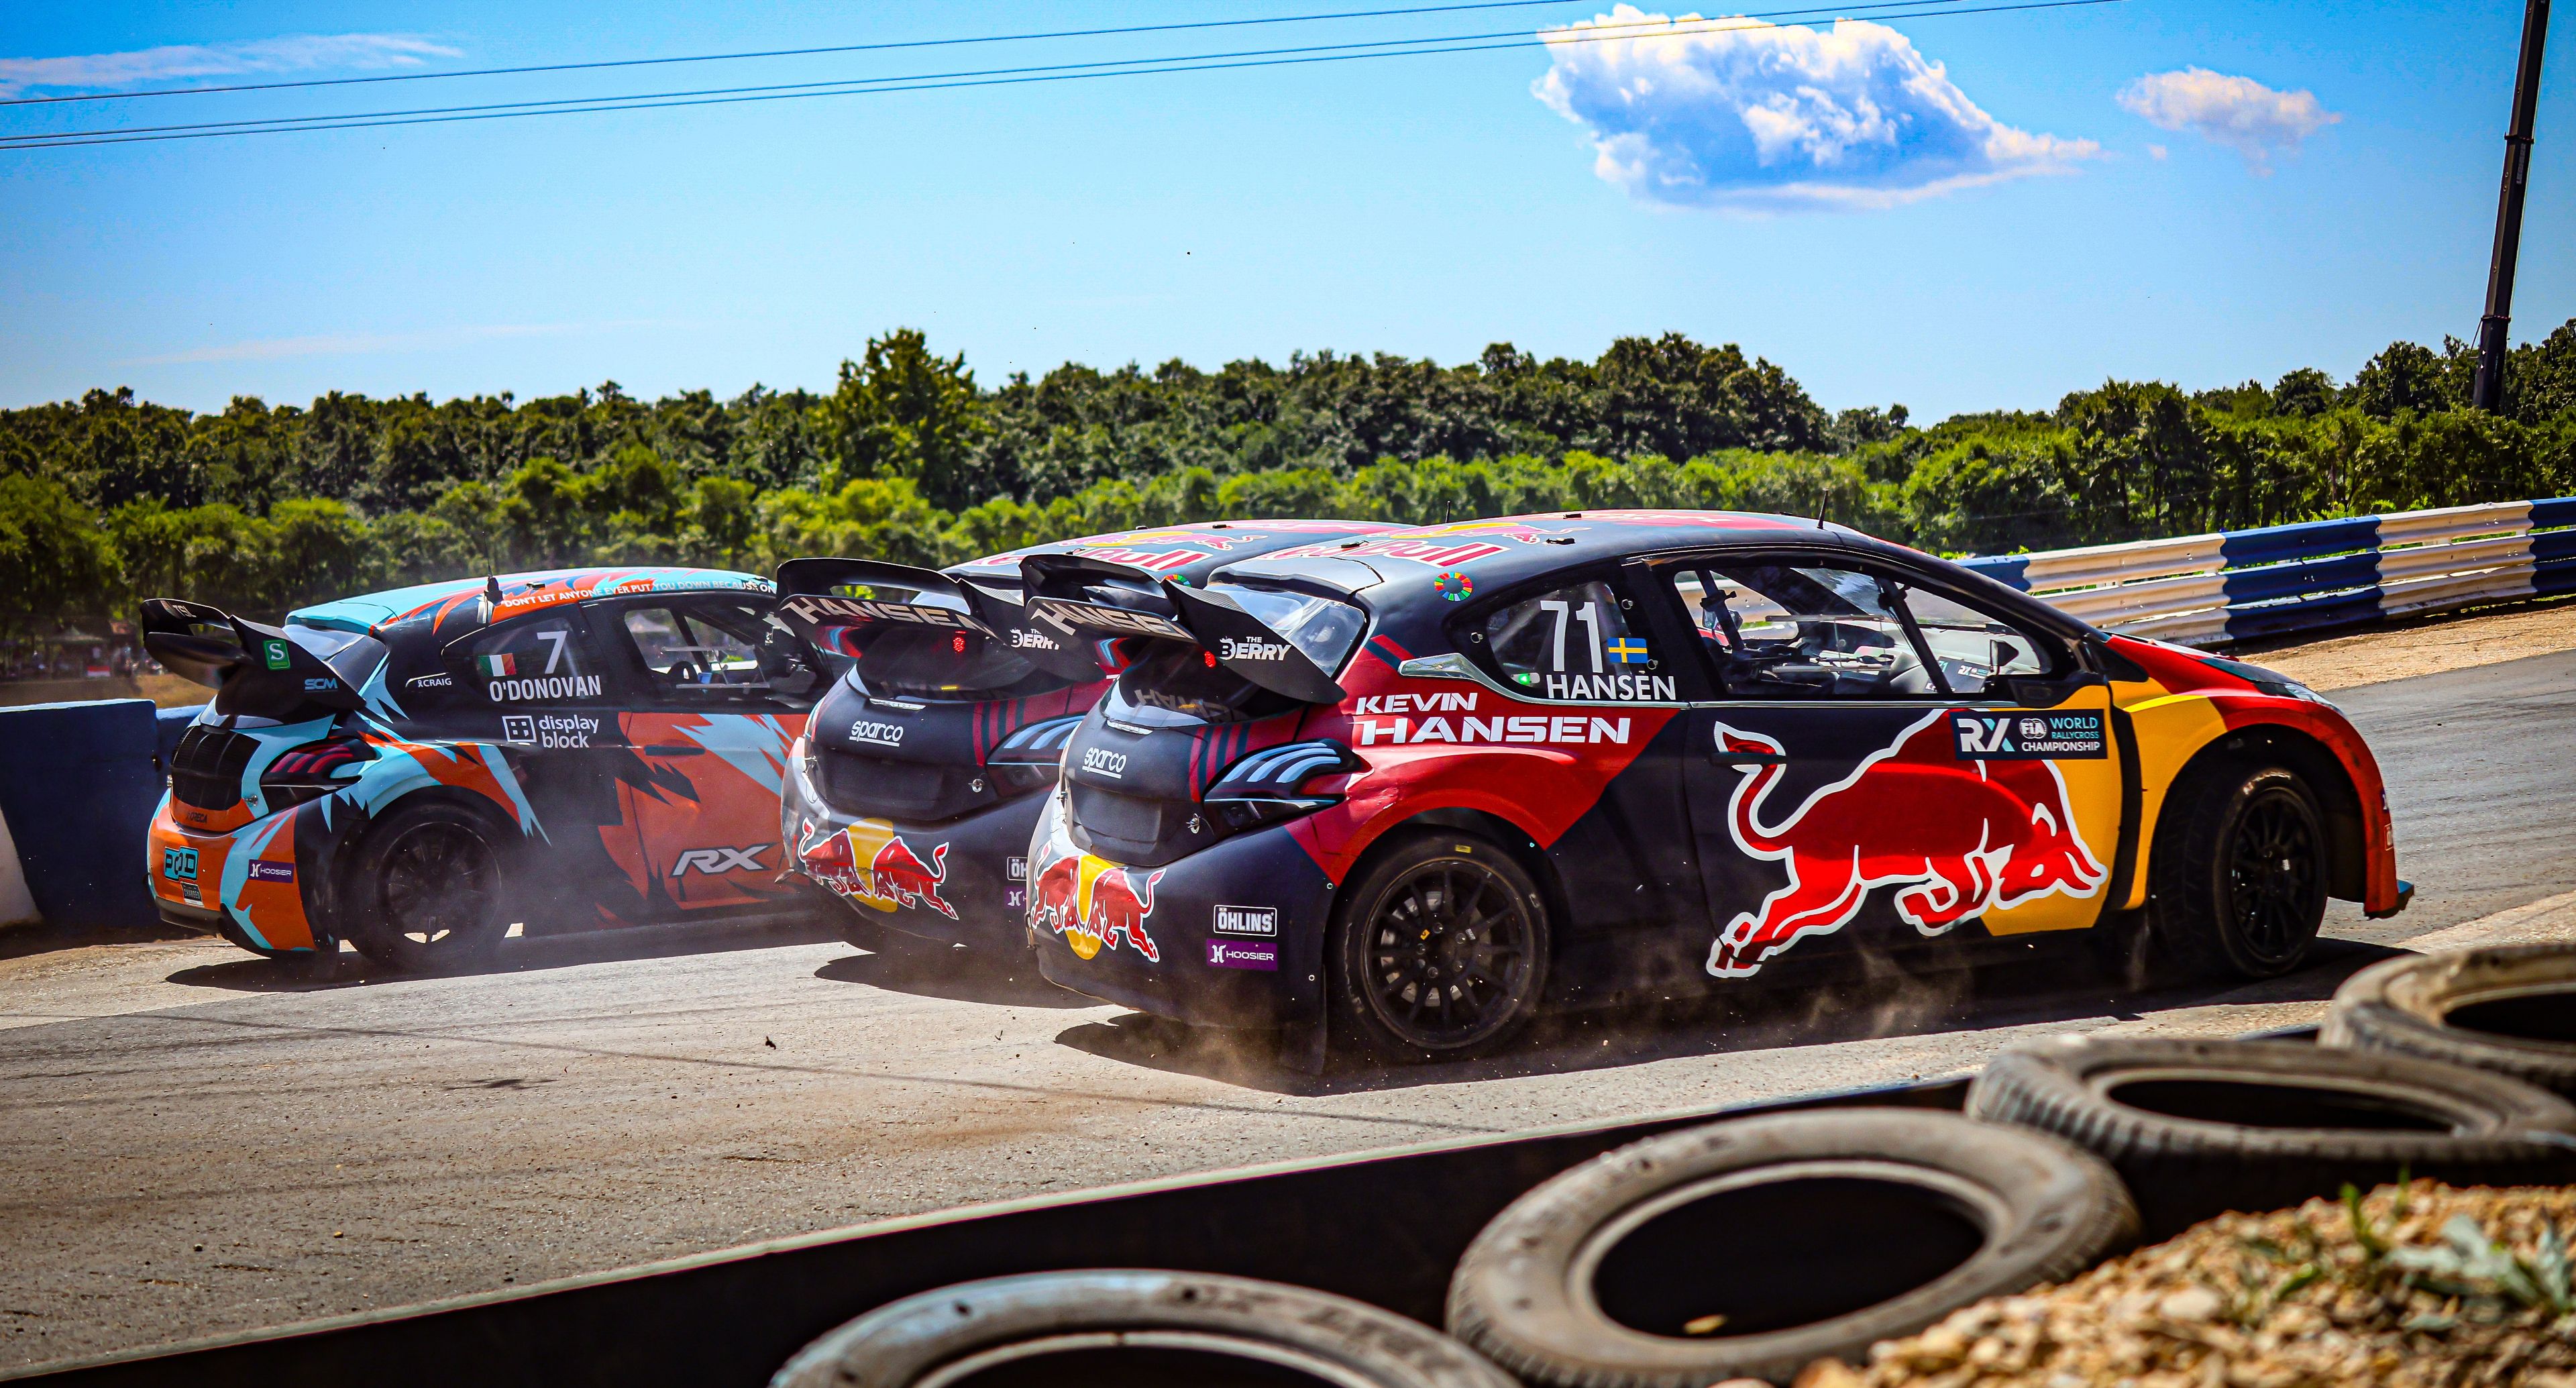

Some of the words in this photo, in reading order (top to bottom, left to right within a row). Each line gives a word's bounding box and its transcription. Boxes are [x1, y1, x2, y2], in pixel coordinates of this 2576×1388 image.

[540, 594, 556, 602] LET
[559, 588, 602, 599] ANYONE
[605, 586, 627, 596] EVER
[632, 584, 651, 592] PUT
[653, 582, 676, 590] YOU
[678, 581, 710, 590] DOWN
[714, 580, 759, 592] BECAUSE
[1541, 600, 1603, 673] 71
[269, 643, 285, 661] S
[537, 631, 568, 674] 7
[1220, 636, 1291, 661] BERRY
[305, 678, 338, 690] SCM
[425, 678, 452, 688] CRAIG
[489, 675, 602, 702] O'DONOVAN
[1546, 674, 1676, 700] HANSEN
[1355, 692, 1477, 715] KEVIN
[539, 714, 599, 734] display
[851, 720, 904, 743] sparco
[1348, 716, 1631, 745] HANSEN
[1957, 718, 2015, 752] RX
[2050, 717, 2098, 730] WORLD
[2051, 731, 2100, 739] RALLYCROSS
[542, 732, 590, 749] block
[2021, 741, 2101, 752] CHAMPIONSHIP
[1083, 747, 1127, 773] sparco
[672, 845, 769, 876] RX
[1226, 951, 1275, 961] HOOSIER
